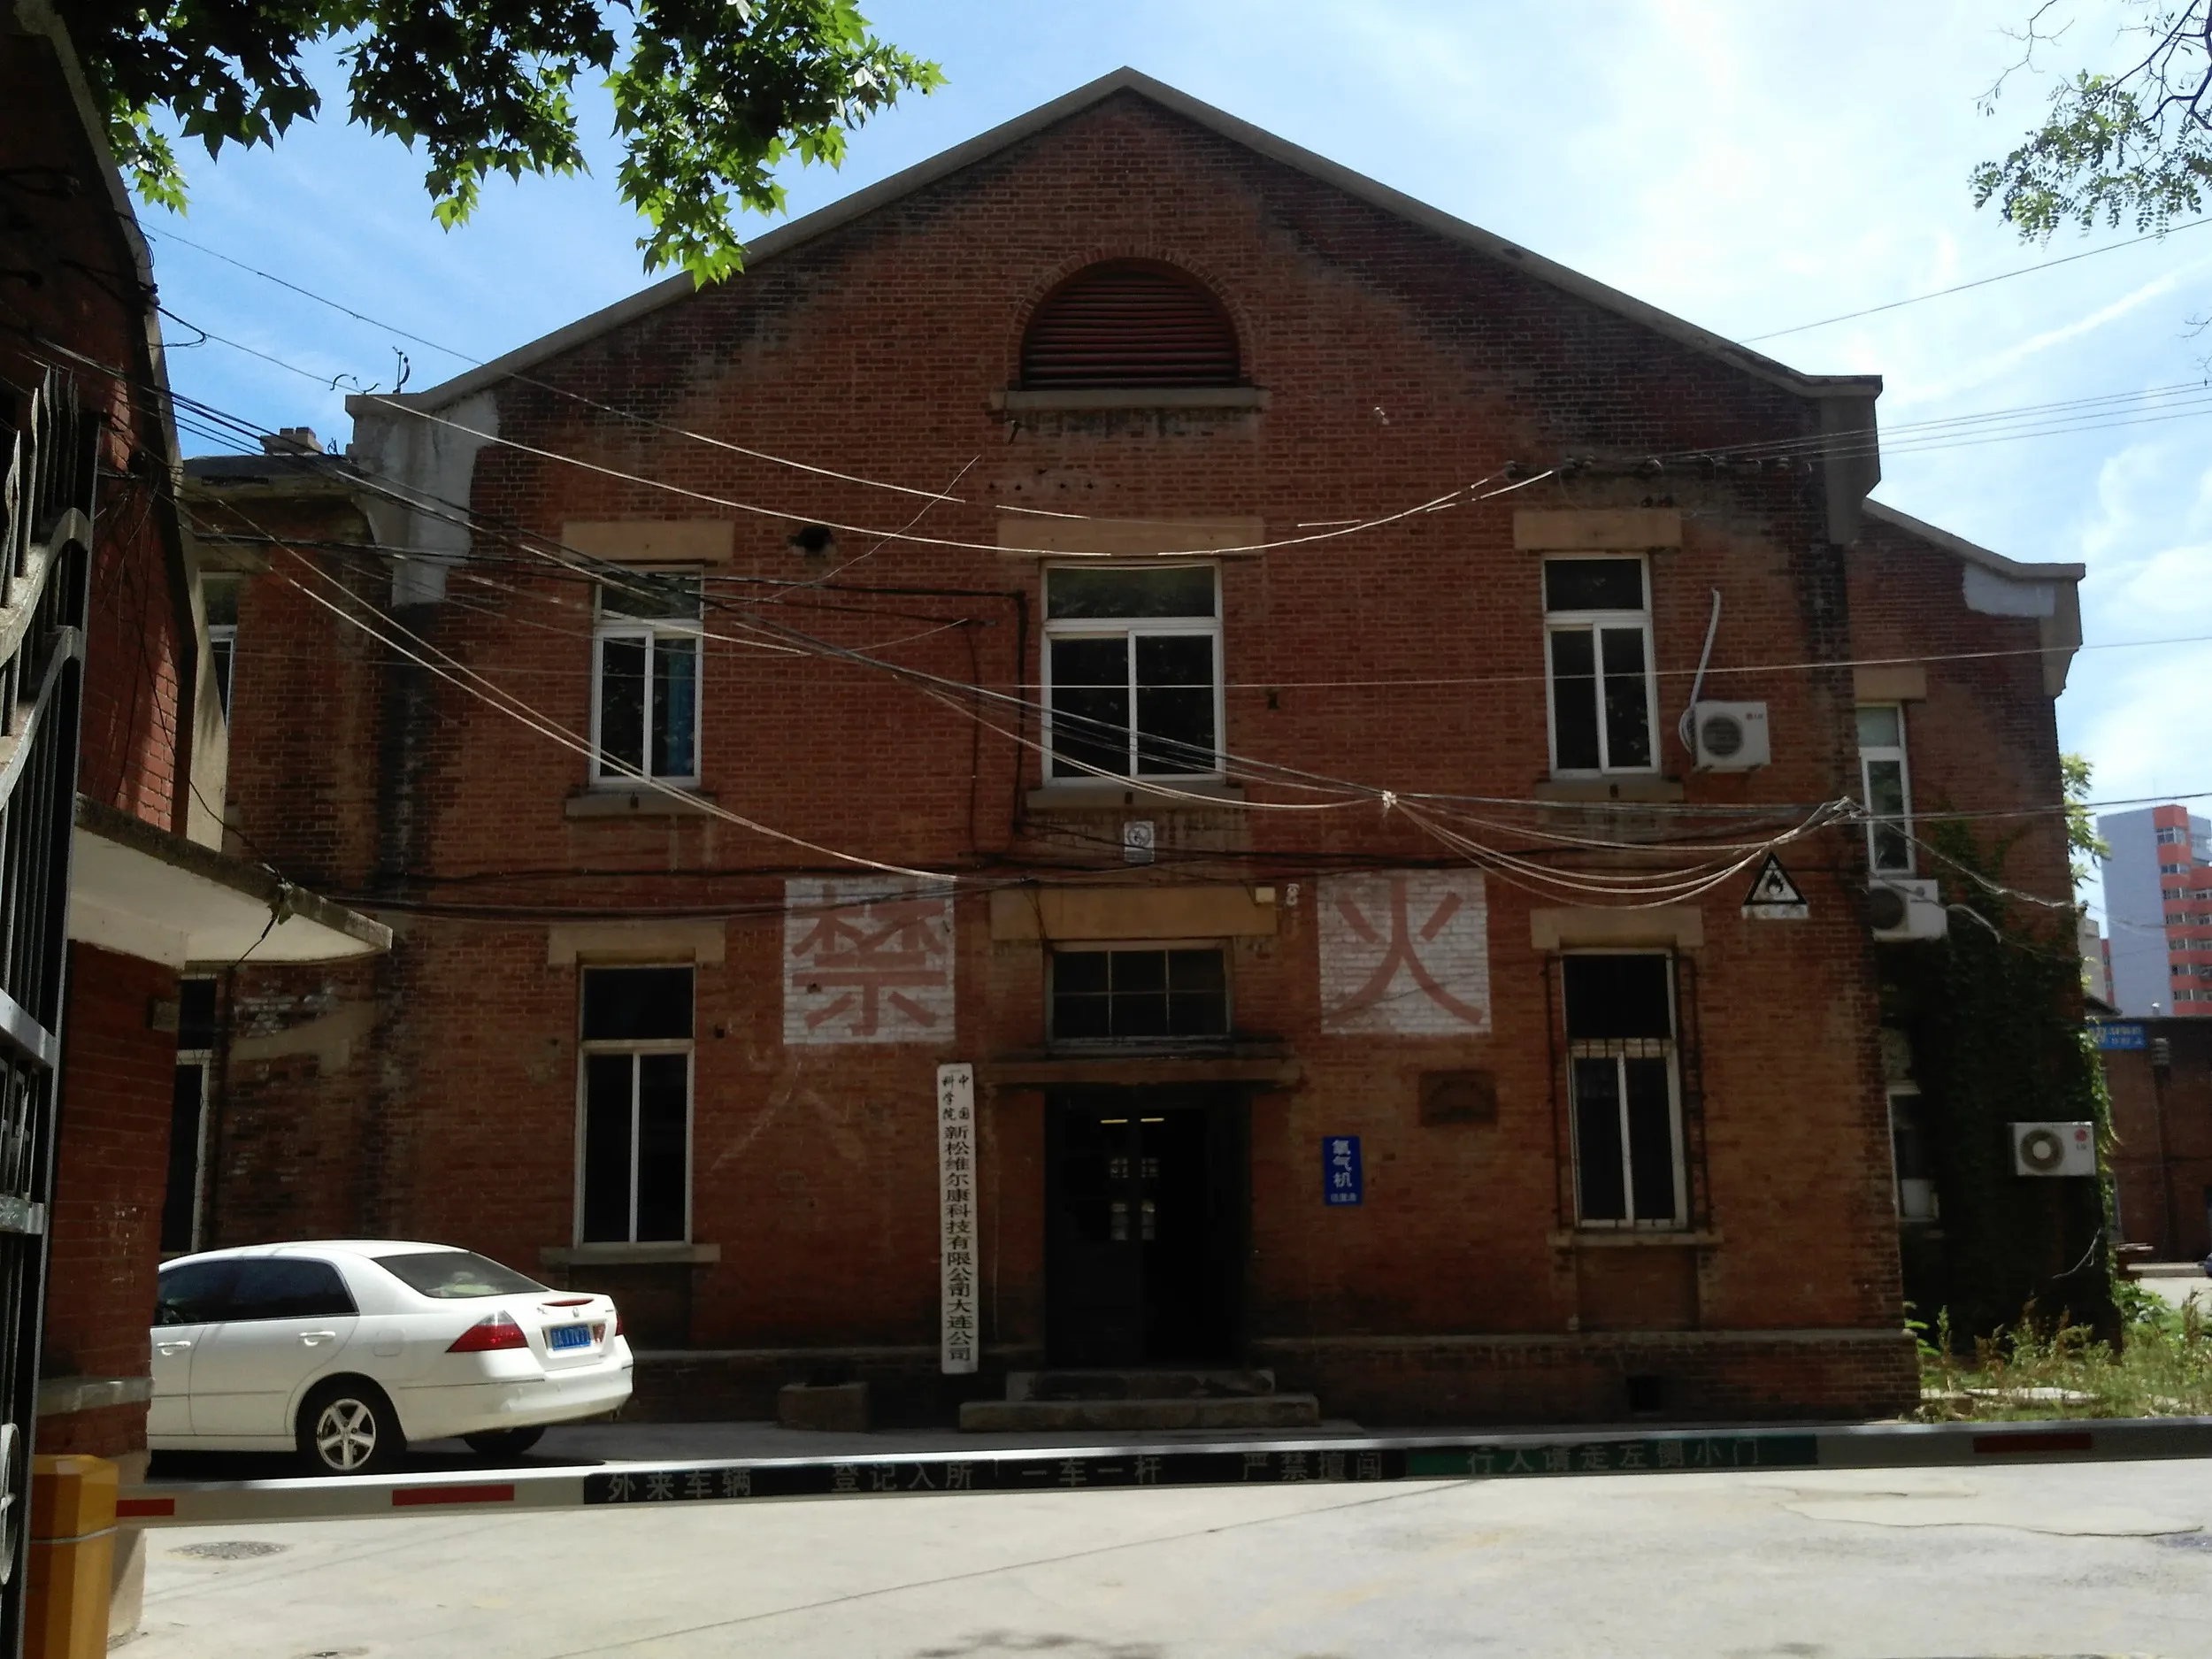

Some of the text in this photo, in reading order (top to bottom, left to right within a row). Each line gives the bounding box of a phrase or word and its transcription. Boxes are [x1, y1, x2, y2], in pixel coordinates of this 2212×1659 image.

[792, 869, 1484, 1037] 禁 火
[945, 1125, 973, 1361] 新松维尔康科技有限公司大连公司
[607, 1469, 752, 1502] 外来车辆
[1022, 1455, 1162, 1486] 一车一杆
